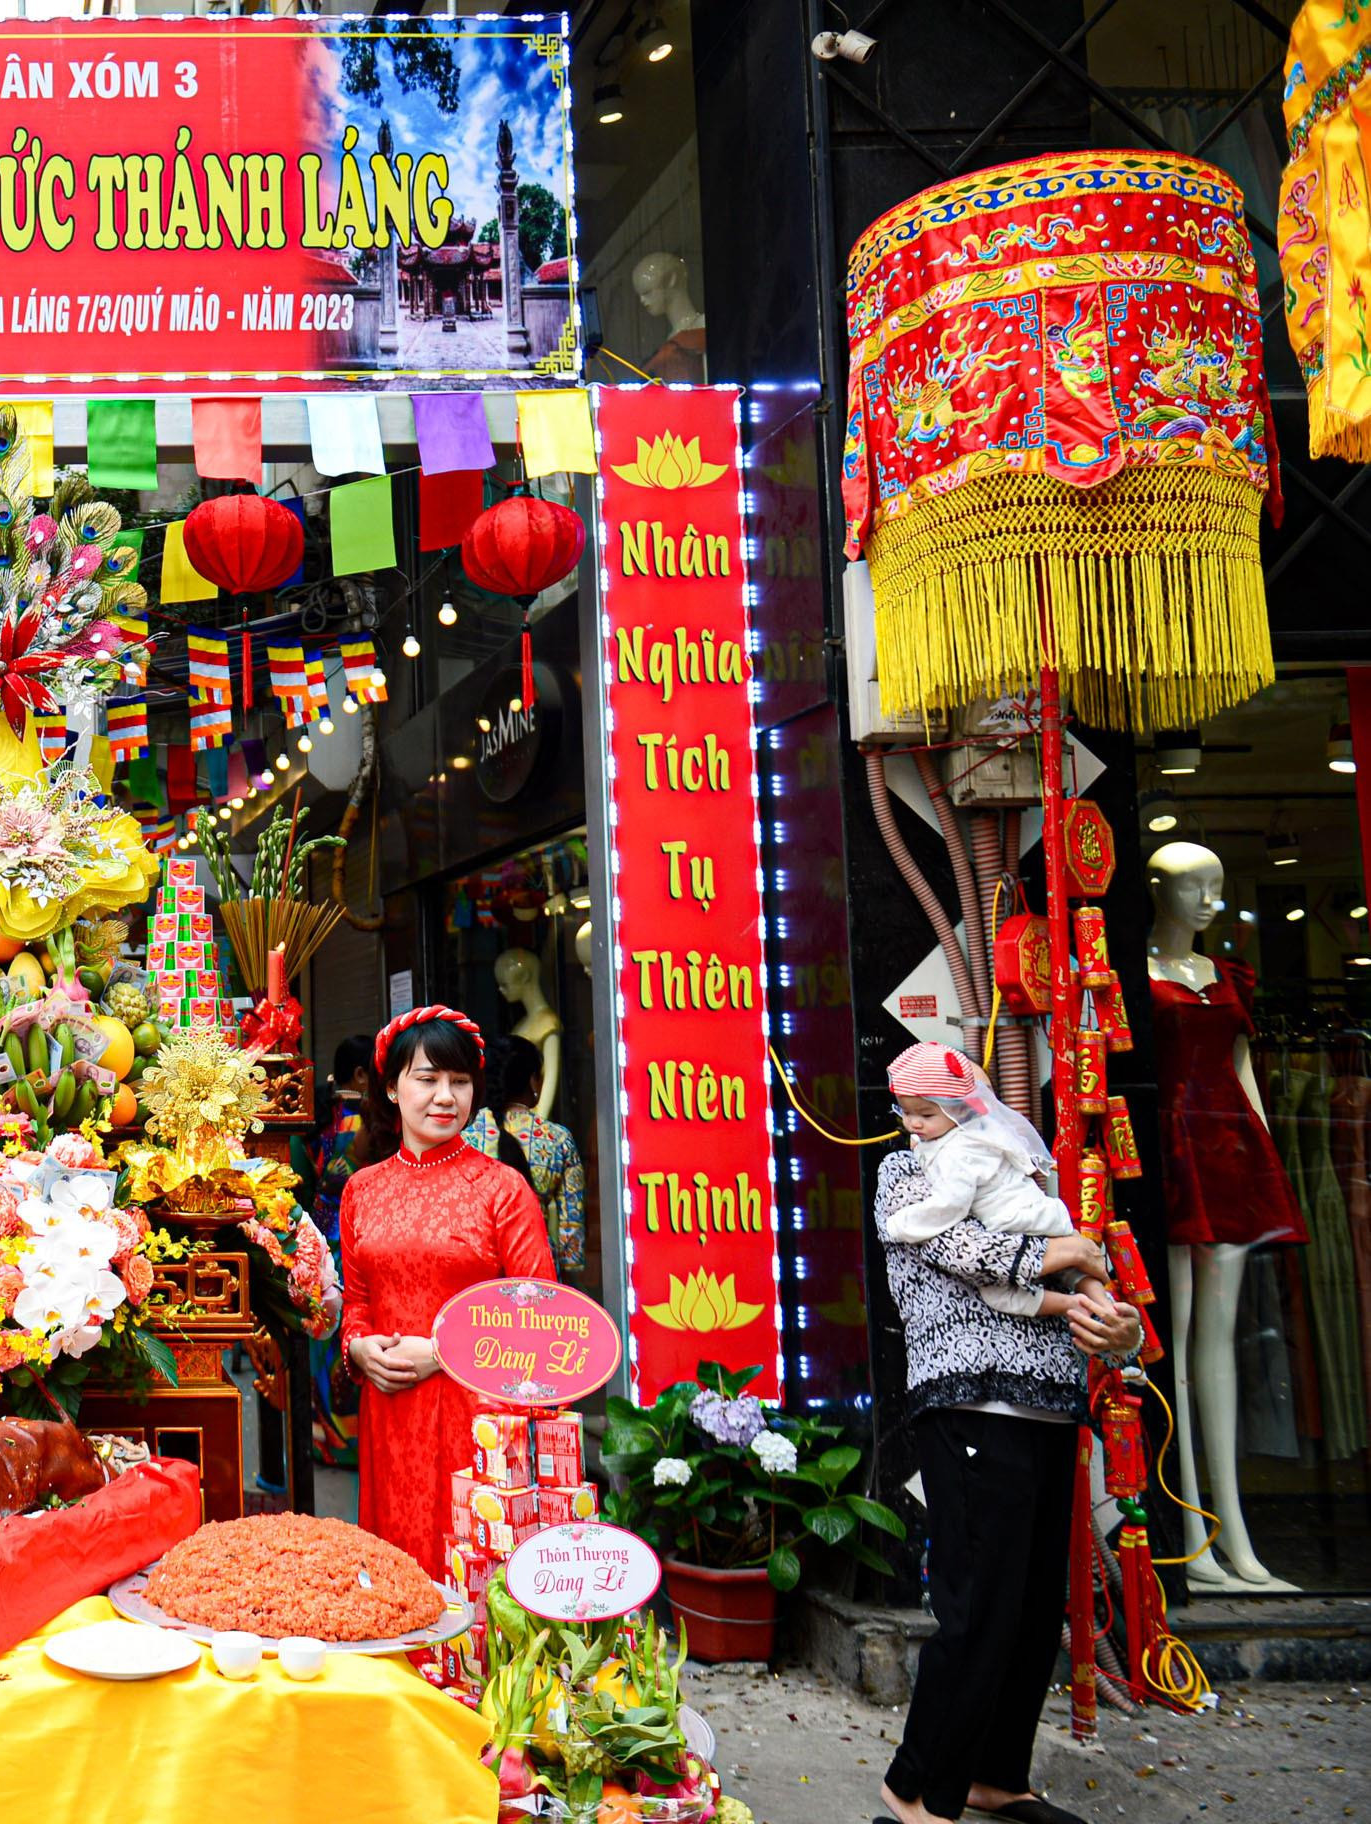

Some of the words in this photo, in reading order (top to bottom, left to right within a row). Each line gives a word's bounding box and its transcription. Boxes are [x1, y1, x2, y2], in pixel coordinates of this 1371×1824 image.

[69, 54, 159, 99] XÓM
[174, 61, 199, 98] 3
[87, 125, 286, 251] THÁNH
[297, 125, 454, 250] LÁNG
[11, 288, 70, 333] LÁNG
[77, 287, 164, 337] 7/3/QUÝ
[170, 287, 220, 332] MÃO
[242, 287, 294, 331] NĂM
[299, 293, 355, 331] 2023
[620, 520, 730, 577] Nhân
[616, 626, 743, 703] Nghĩa
[637, 733, 730, 791] Tích
[661, 840, 715, 911] Tụ
[632, 950, 753, 1010] Thiên
[648, 1060, 746, 1120] Niên
[638, 1171, 762, 1247] Thịnh
[468, 1305, 512, 1328] Thôn
[517, 1307, 590, 1338] Thượng
[473, 1336, 536, 1381] Dâng
[546, 1340, 590, 1376] Lễ
[537, 1547, 570, 1564] Thôn
[573, 1545, 629, 1565] Thượng
[593, 1565, 628, 1592] Lễ
